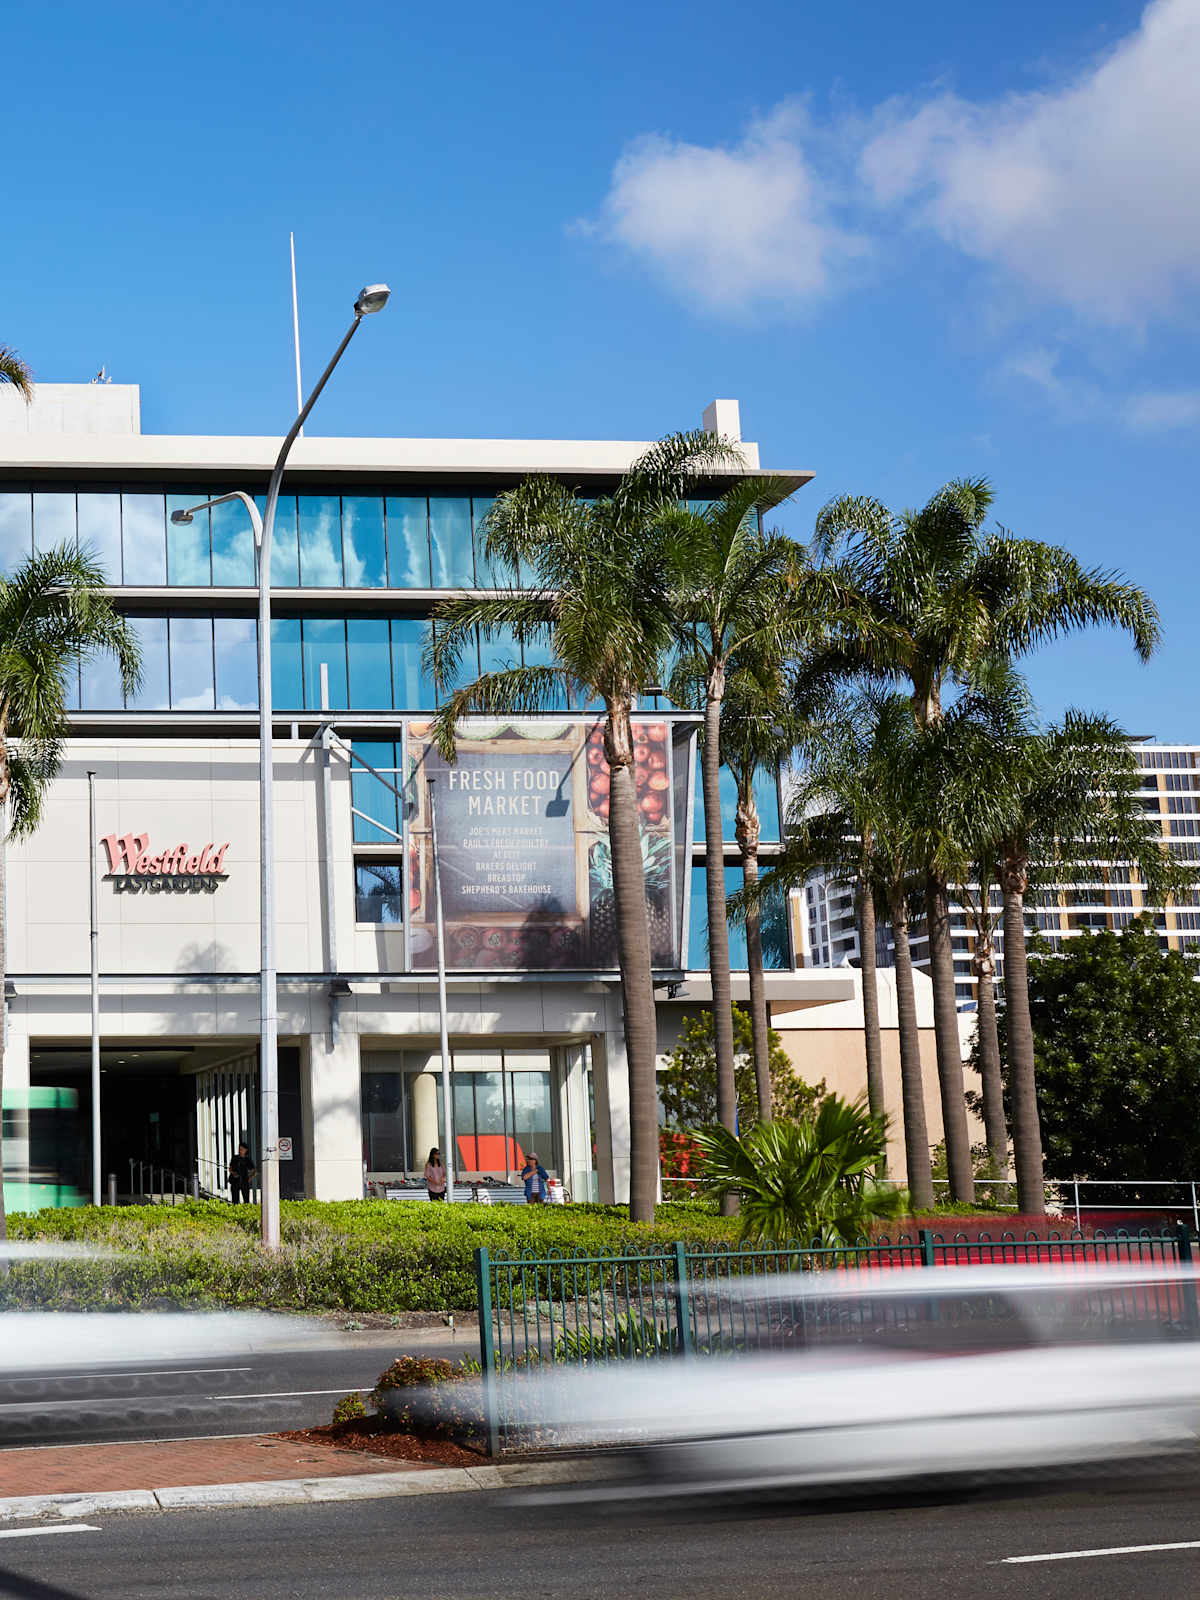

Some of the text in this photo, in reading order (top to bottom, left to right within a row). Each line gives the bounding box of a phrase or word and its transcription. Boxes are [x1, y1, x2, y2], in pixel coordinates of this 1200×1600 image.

[449, 770, 560, 791] FRESH FOOD
[468, 795, 542, 816] MARKET
[99, 832, 230, 874] Westfield
[115, 878, 220, 891] EASTGARDENS
[508, 884, 552, 894] BAKEHOUSE
